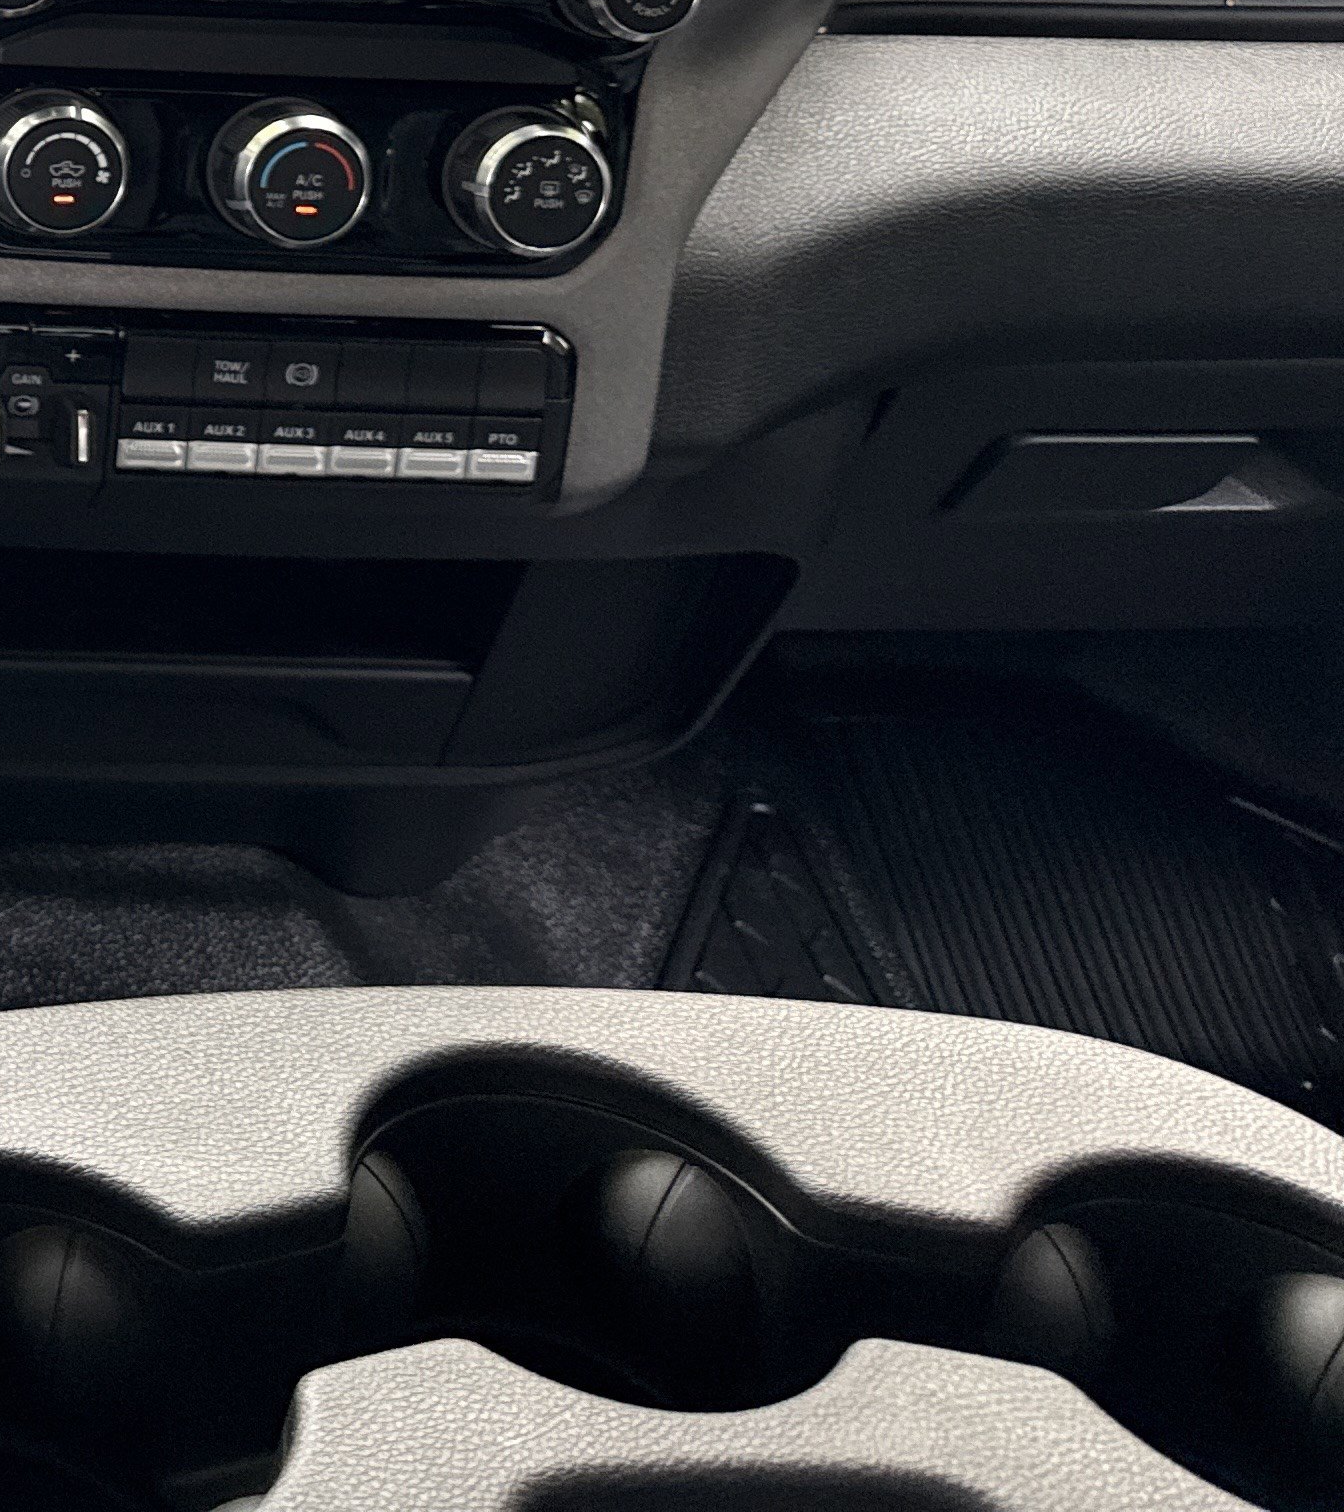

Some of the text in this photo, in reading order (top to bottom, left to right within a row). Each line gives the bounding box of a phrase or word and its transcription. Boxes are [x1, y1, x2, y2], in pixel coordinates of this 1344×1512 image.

[51, 177, 83, 189] PUSH
[295, 173, 324, 187] A/C
[291, 189, 324, 201] PUSH
[533, 197, 565, 210] PUSH
[213, 359, 250, 374] TOW/
[12, 372, 43, 386] GAIN
[213, 372, 249, 385] HAUL
[132, 421, 176, 434] AUX 1
[204, 424, 246, 437] AUX 2
[273, 426, 315, 439] AUX 3
[344, 429, 385, 442] AUX 4
[414, 431, 454, 444] AUX 5
[488, 433, 519, 445] PTO
